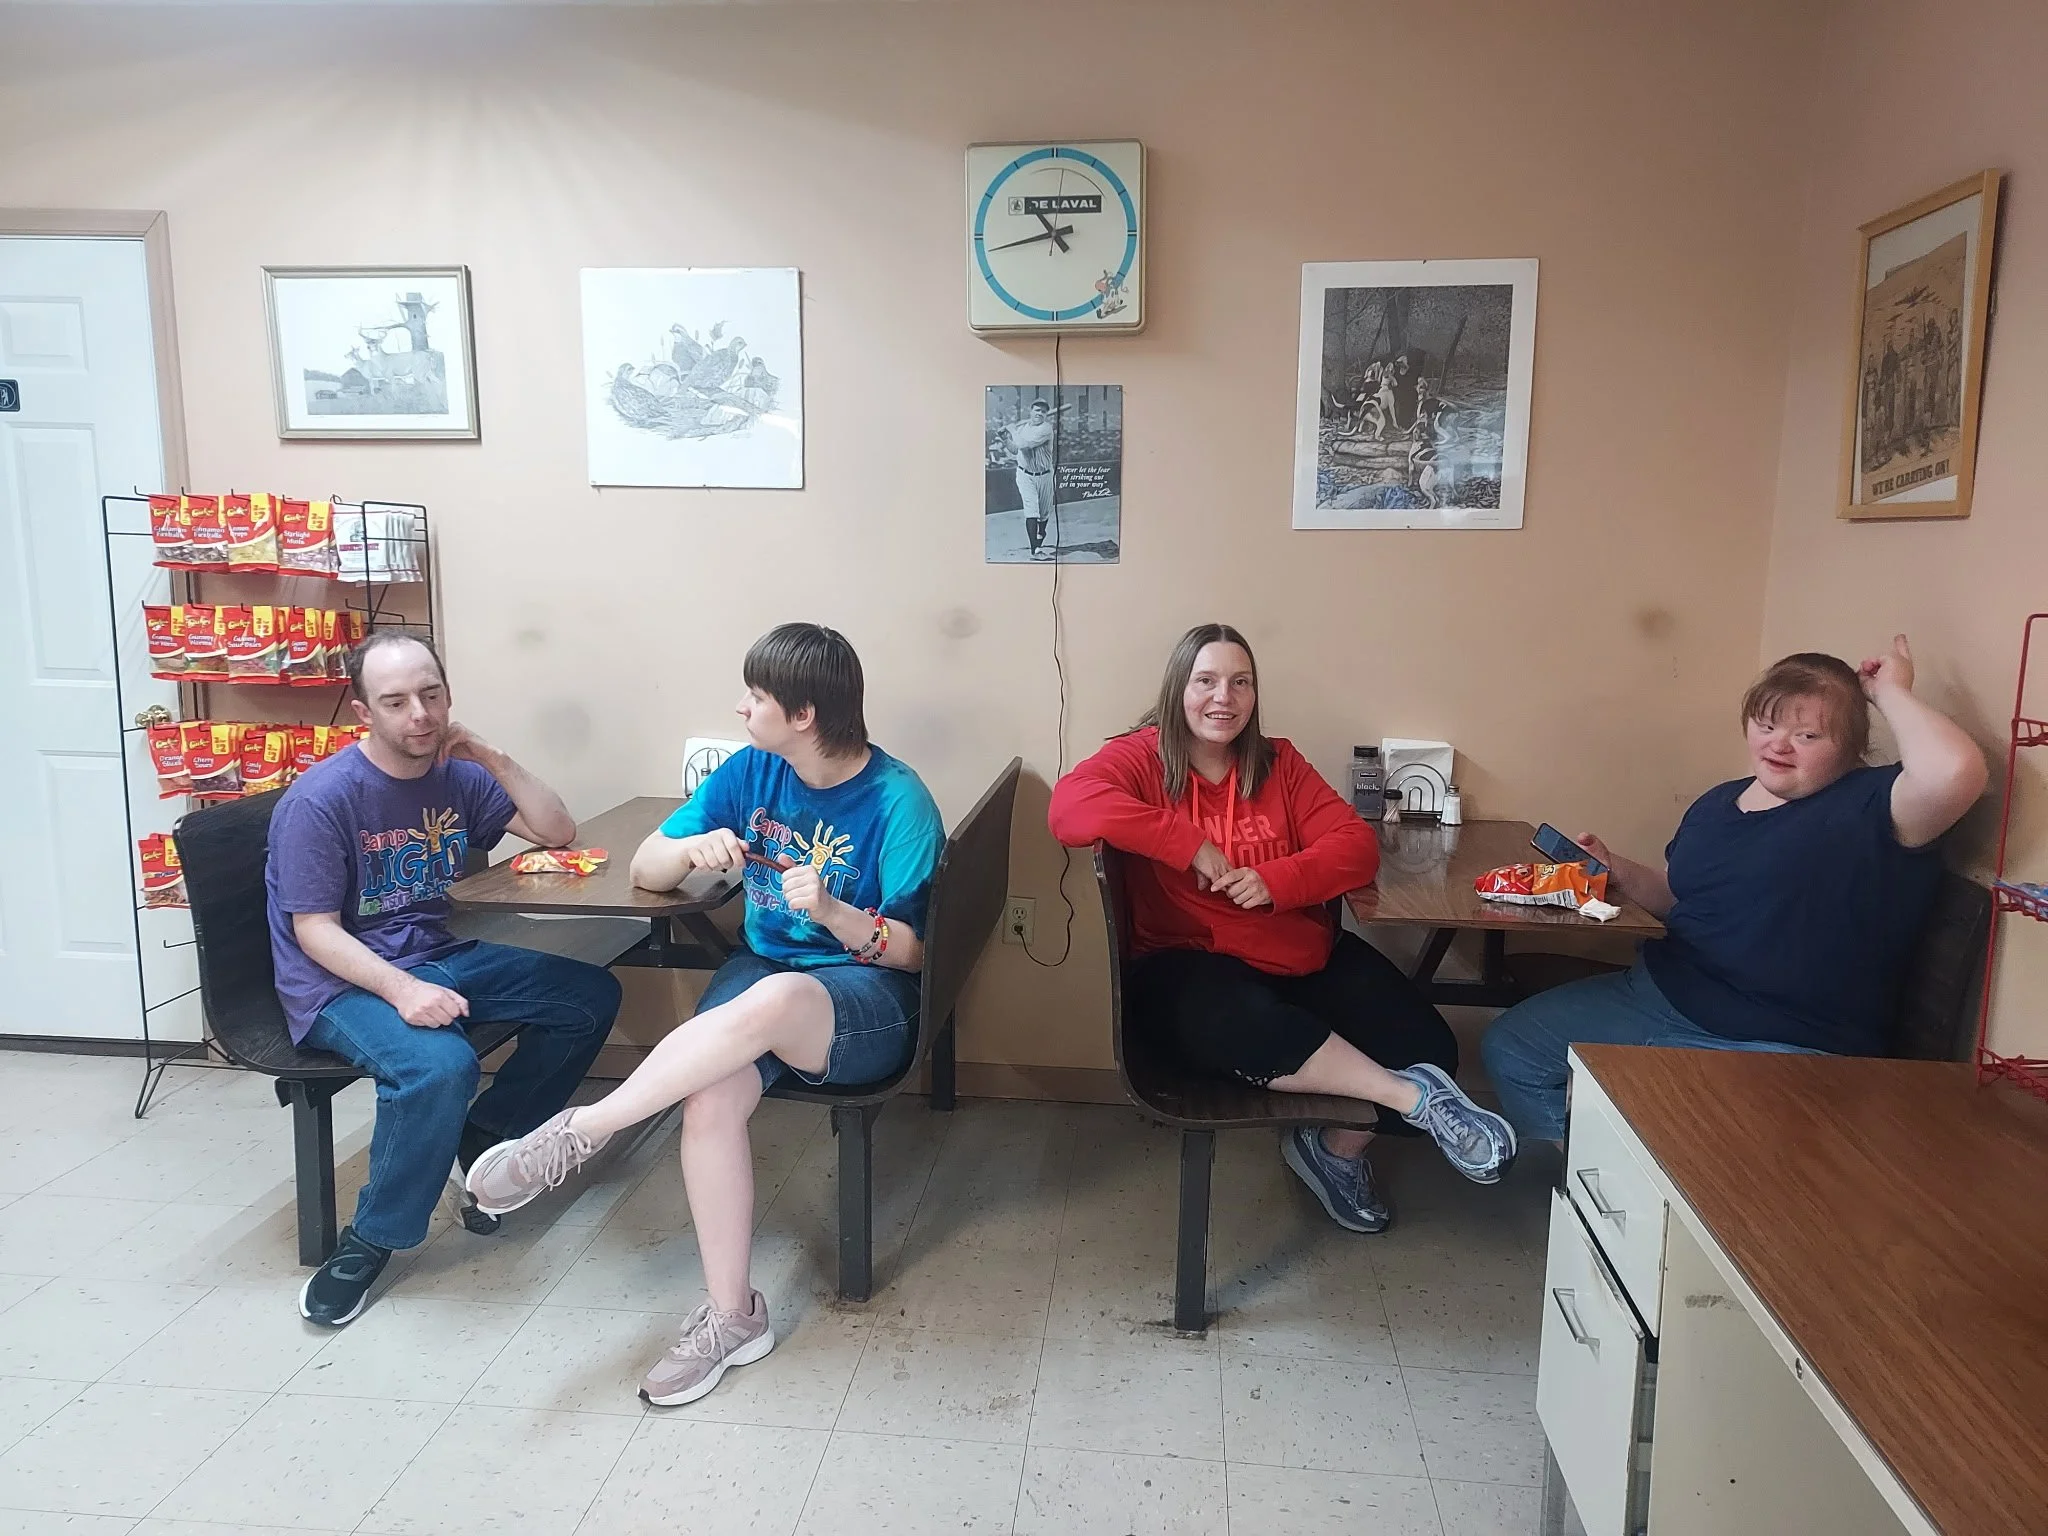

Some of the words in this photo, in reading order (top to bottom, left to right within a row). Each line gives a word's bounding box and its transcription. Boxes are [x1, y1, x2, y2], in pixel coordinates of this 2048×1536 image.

[1051, 199, 1097, 209] LAVAL
[1062, 473, 1070, 481] of
[1070, 473, 1093, 481] striking
[1096, 466, 1111, 474] fear
[750, 807, 793, 849] Camp
[360, 829, 409, 852] Camp
[360, 828, 468, 899] LIGHT
